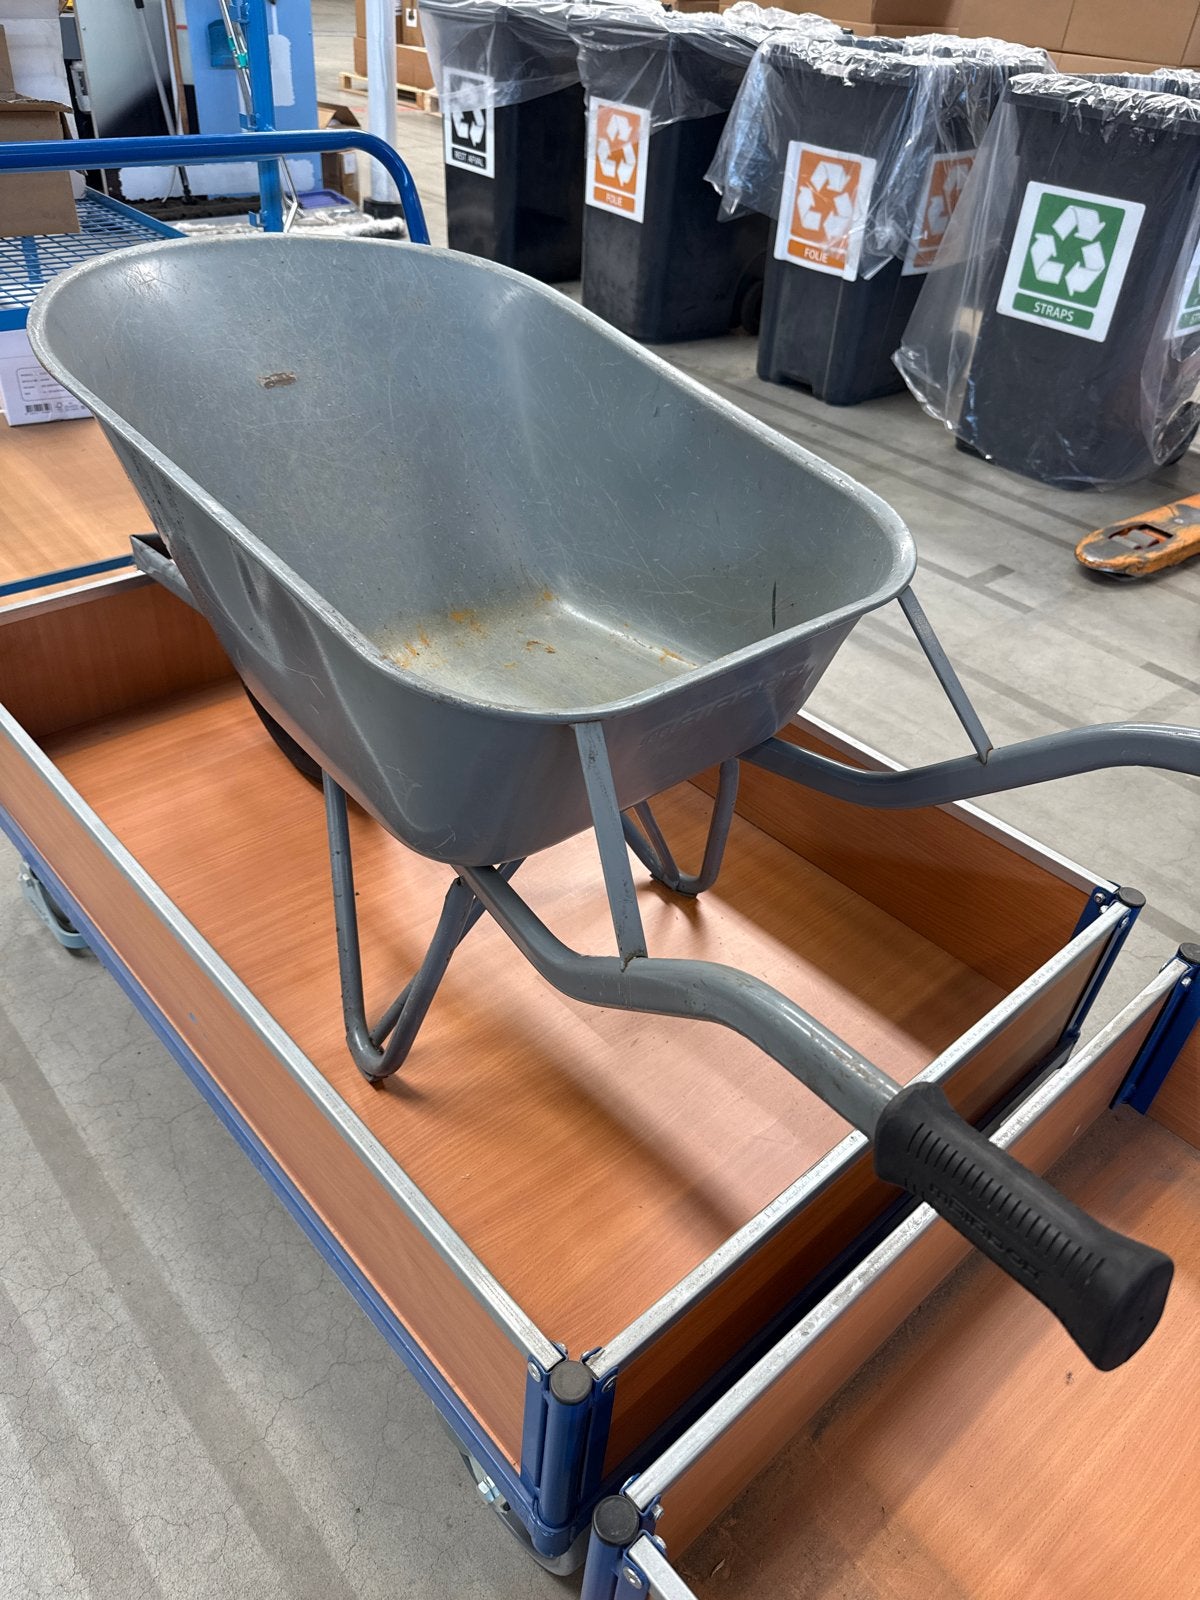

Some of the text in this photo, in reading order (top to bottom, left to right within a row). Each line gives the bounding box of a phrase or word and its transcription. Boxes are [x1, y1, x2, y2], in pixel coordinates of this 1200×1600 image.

[605, 191, 623, 207] FOLIE
[803, 247, 828, 264] FOLIE
[1033, 301, 1075, 322] STRAPS
